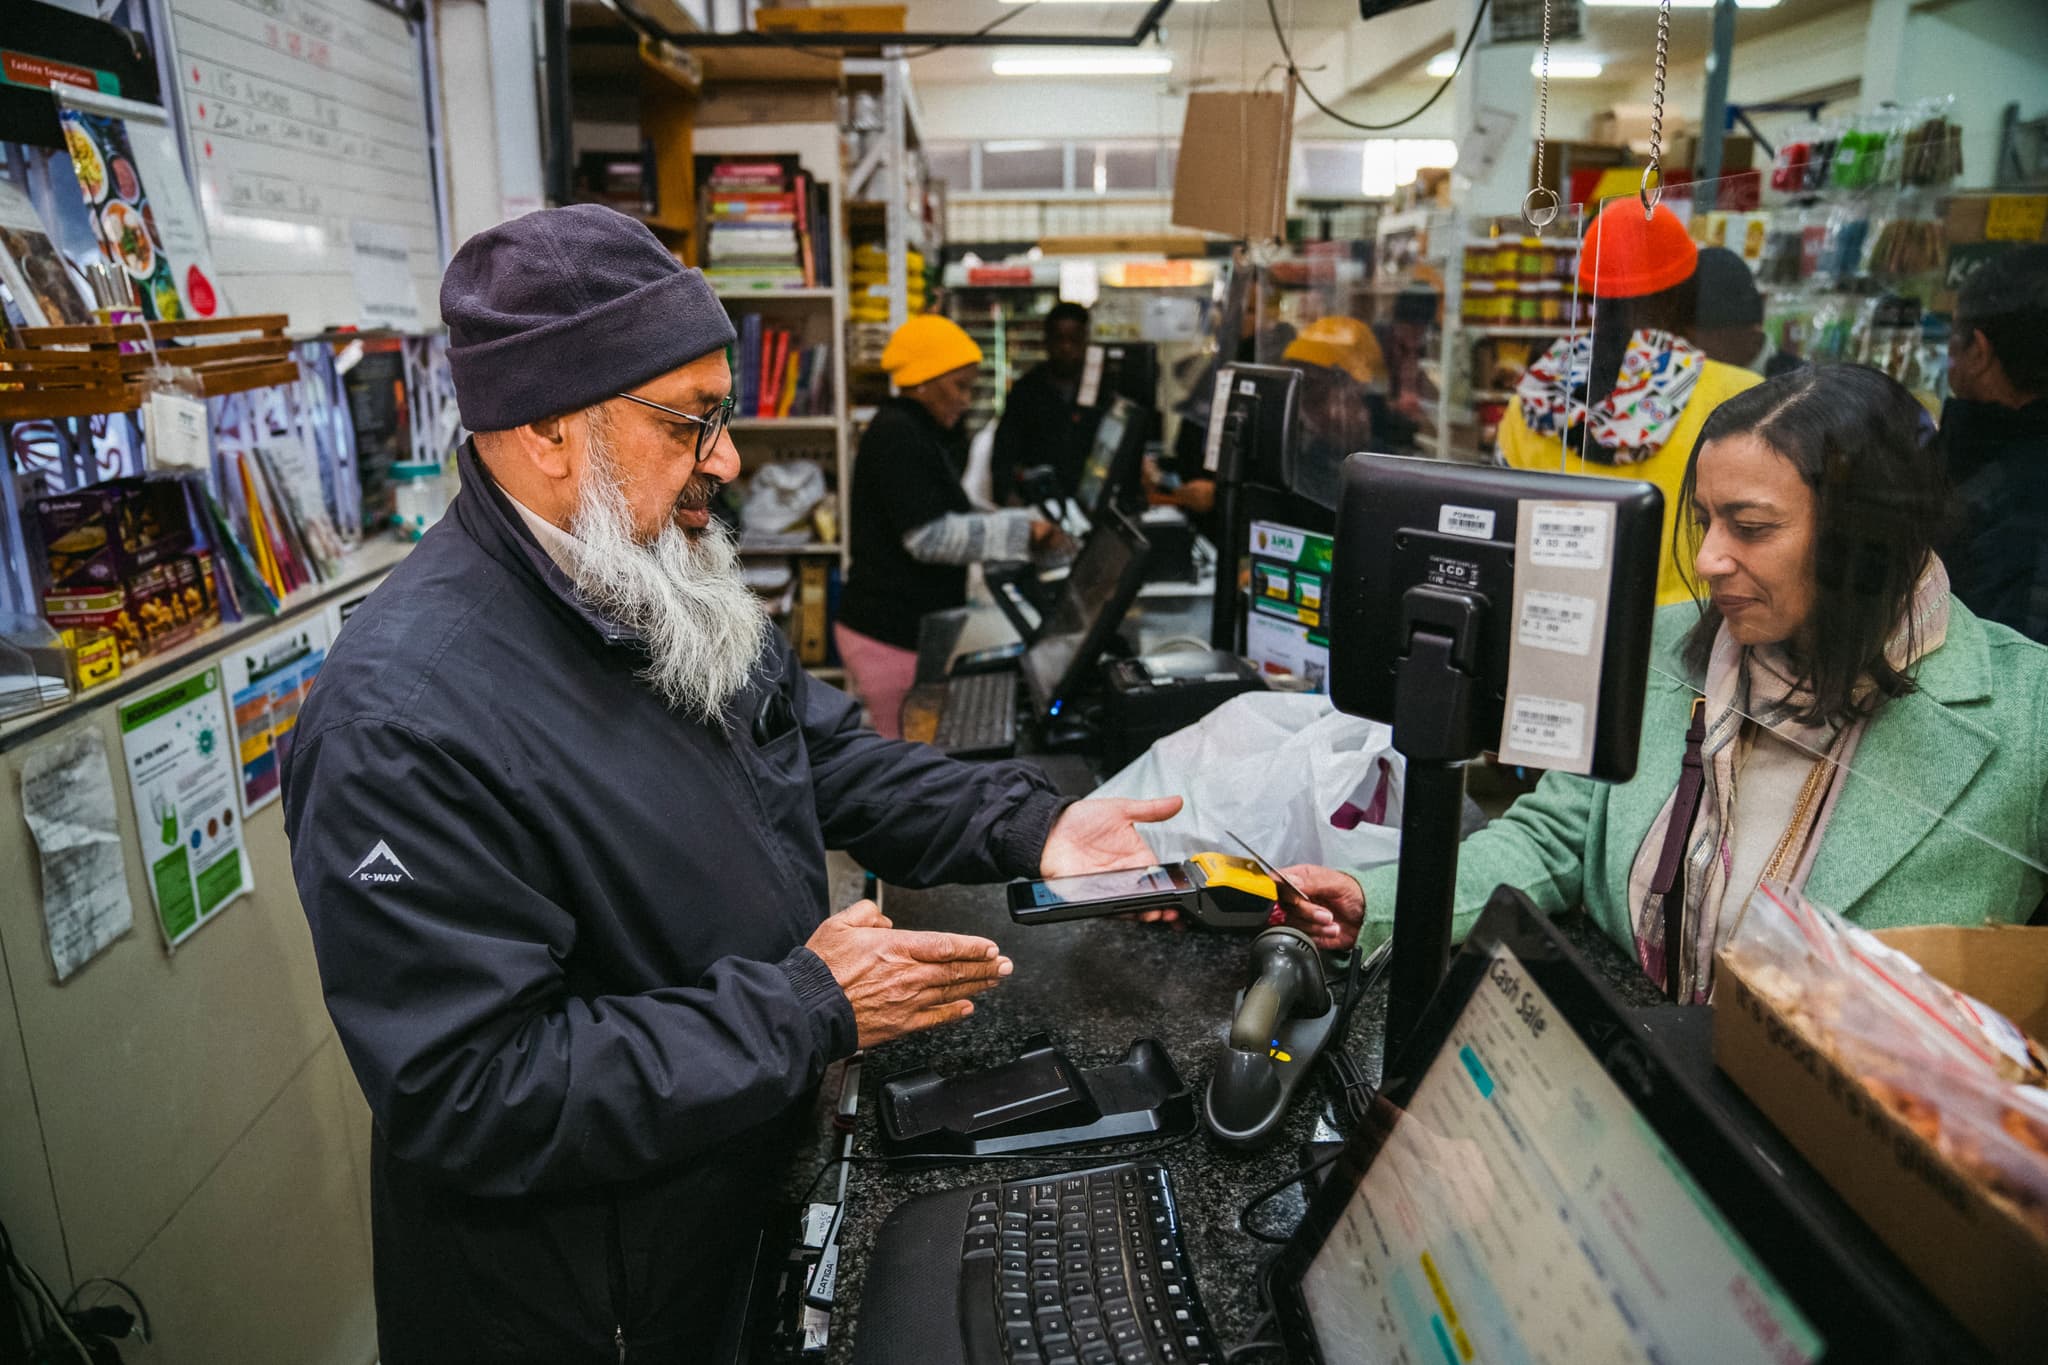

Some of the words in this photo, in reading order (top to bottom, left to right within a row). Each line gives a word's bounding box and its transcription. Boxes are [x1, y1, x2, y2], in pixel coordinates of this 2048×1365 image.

[1439, 563, 1465, 577] LCD
[360, 872, 402, 882] K-WAY
[1489, 958, 1520, 1003] Cash
[1515, 991, 1547, 1039] Sale
[817, 1263, 834, 1295] CATIGA
